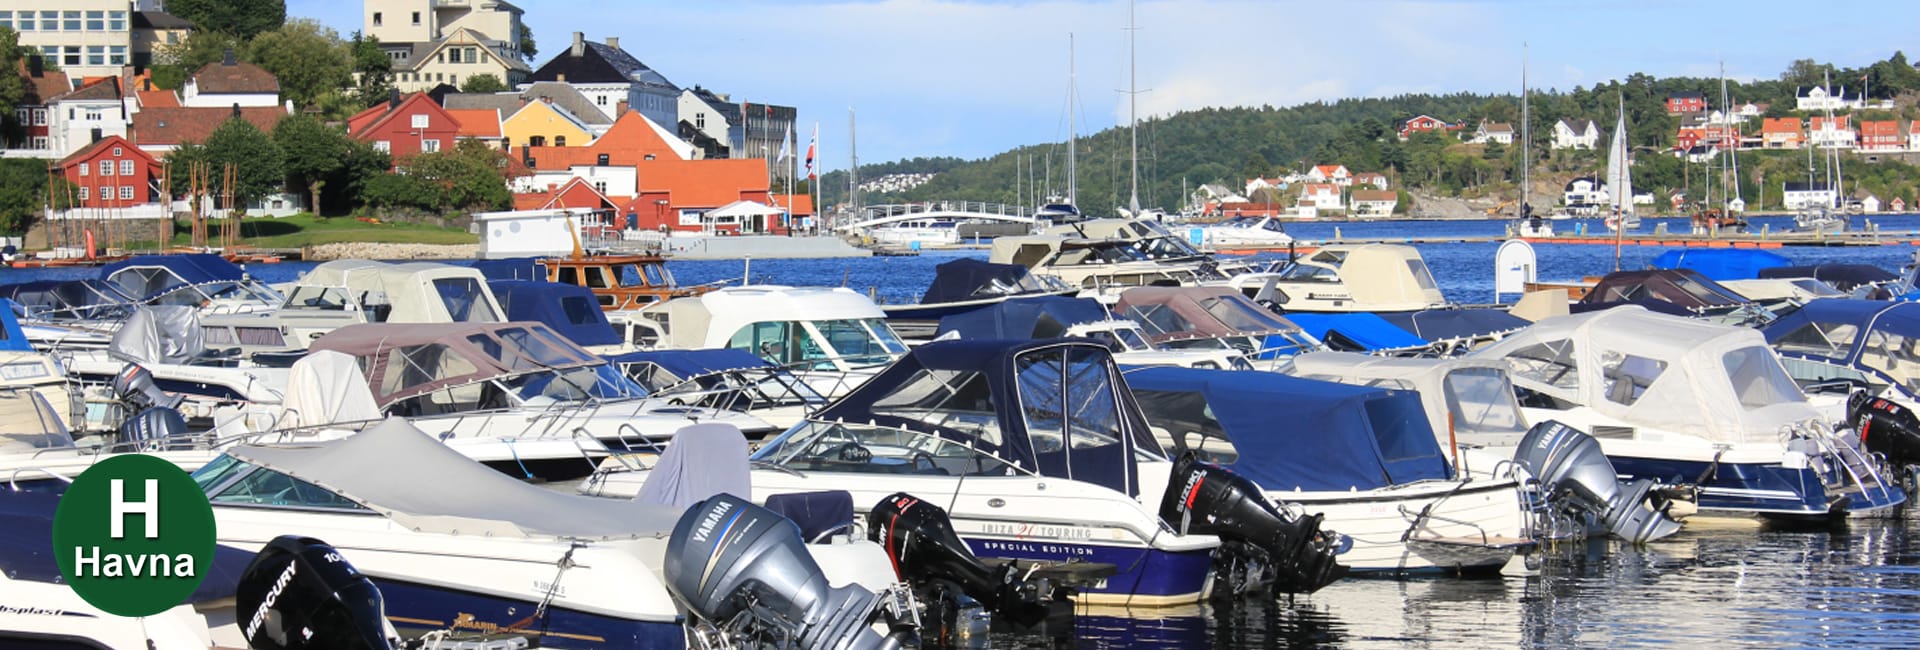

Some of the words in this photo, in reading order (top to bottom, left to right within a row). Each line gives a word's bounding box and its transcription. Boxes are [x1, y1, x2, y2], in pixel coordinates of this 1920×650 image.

[1176, 469, 1201, 513] SUZUKI
[693, 501, 733, 543] YAMAHA
[982, 523, 1014, 534] IBIZA
[1040, 527, 1092, 539] TOURING
[984, 542, 1036, 552] SPECIAL
[1042, 545, 1094, 556] EDITION
[246, 559, 297, 642] MERCURY
